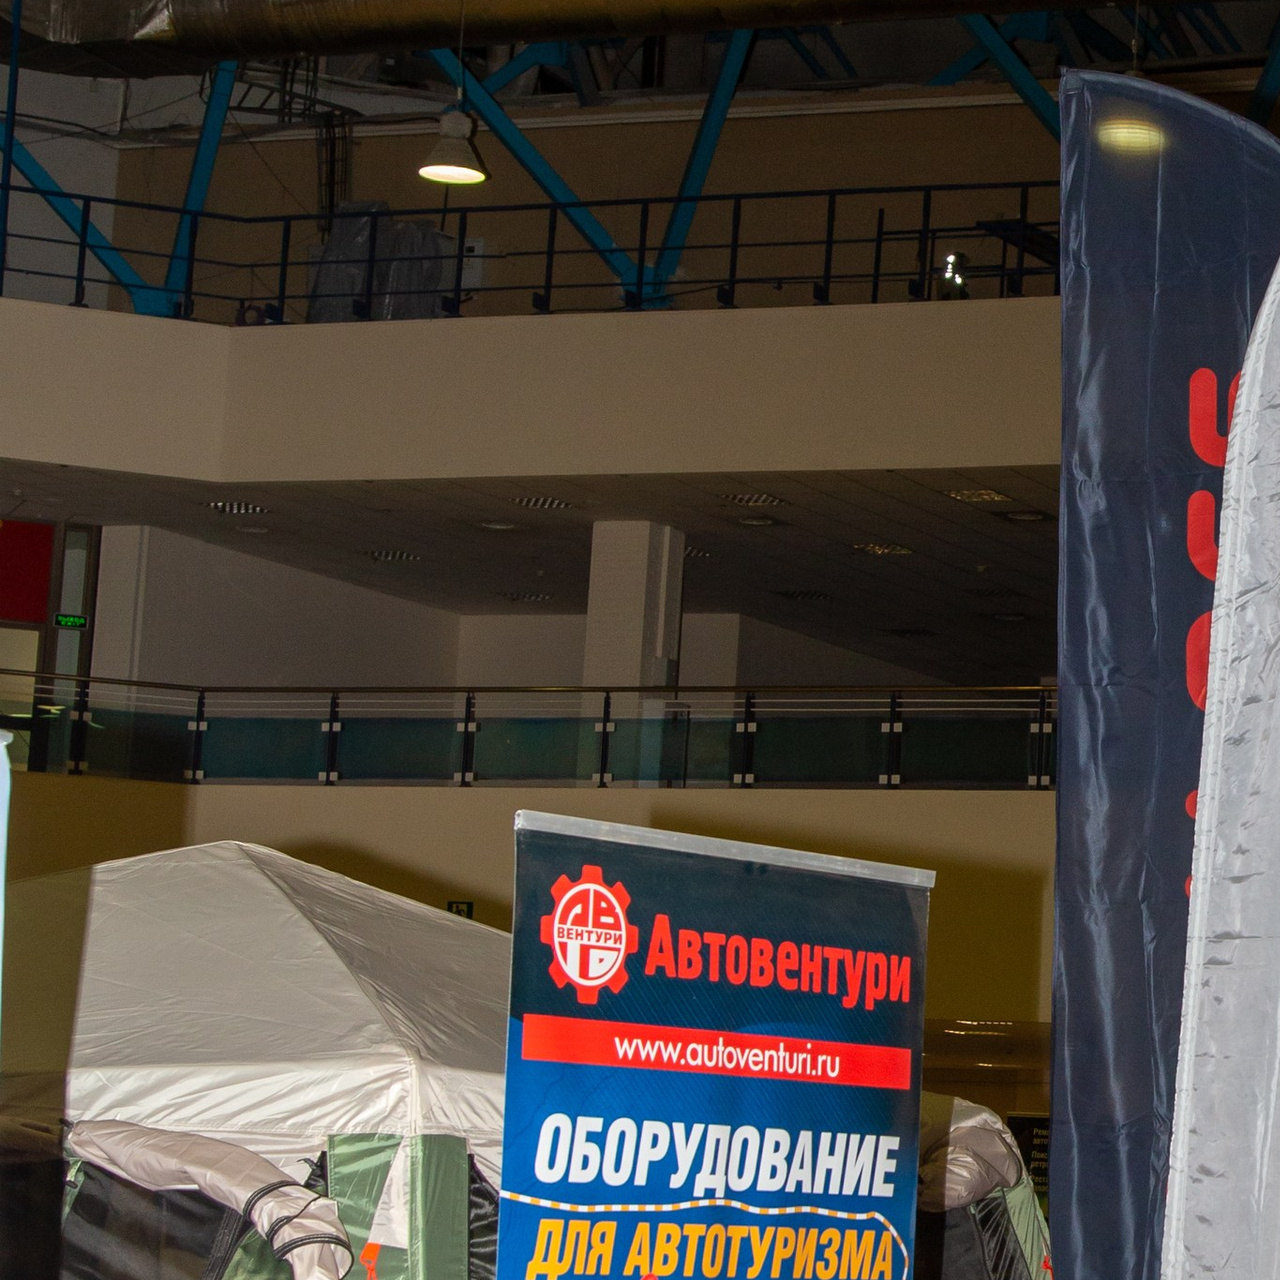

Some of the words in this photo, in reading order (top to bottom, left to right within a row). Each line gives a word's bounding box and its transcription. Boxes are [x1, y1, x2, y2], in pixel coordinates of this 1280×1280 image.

[557, 925, 623, 946] ВЕНТУРИ
[645, 914, 912, 1011] Автовентури
[614, 1036, 840, 1079] www.autoventuri.ru
[534, 1112, 901, 1199] ОБОРУДОВАНИЕ
[623, 1222, 893, 1280] АВТОТУРИЗМА
